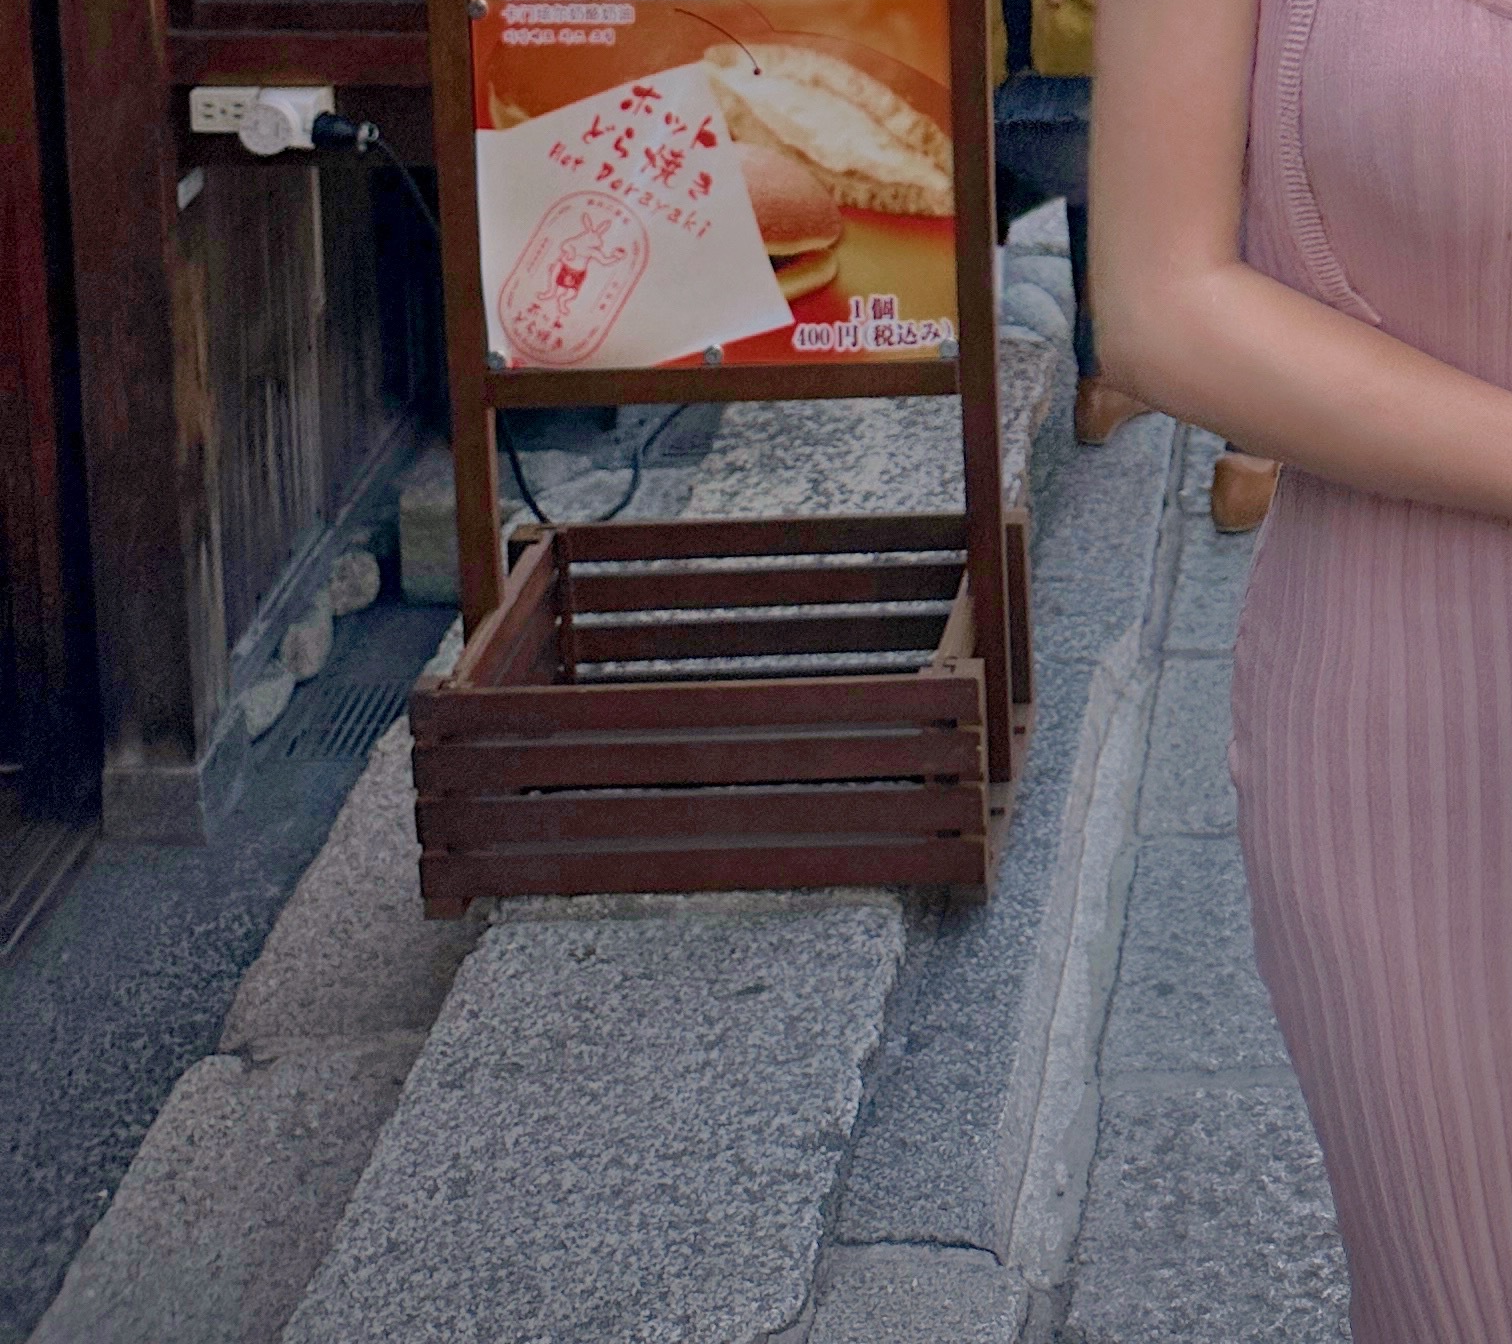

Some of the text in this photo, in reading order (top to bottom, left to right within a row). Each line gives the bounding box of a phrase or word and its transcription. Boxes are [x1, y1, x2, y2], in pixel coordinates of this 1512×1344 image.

[581, 113, 713, 201] どら焼き
[595, 162, 713, 239] Dorayaki
